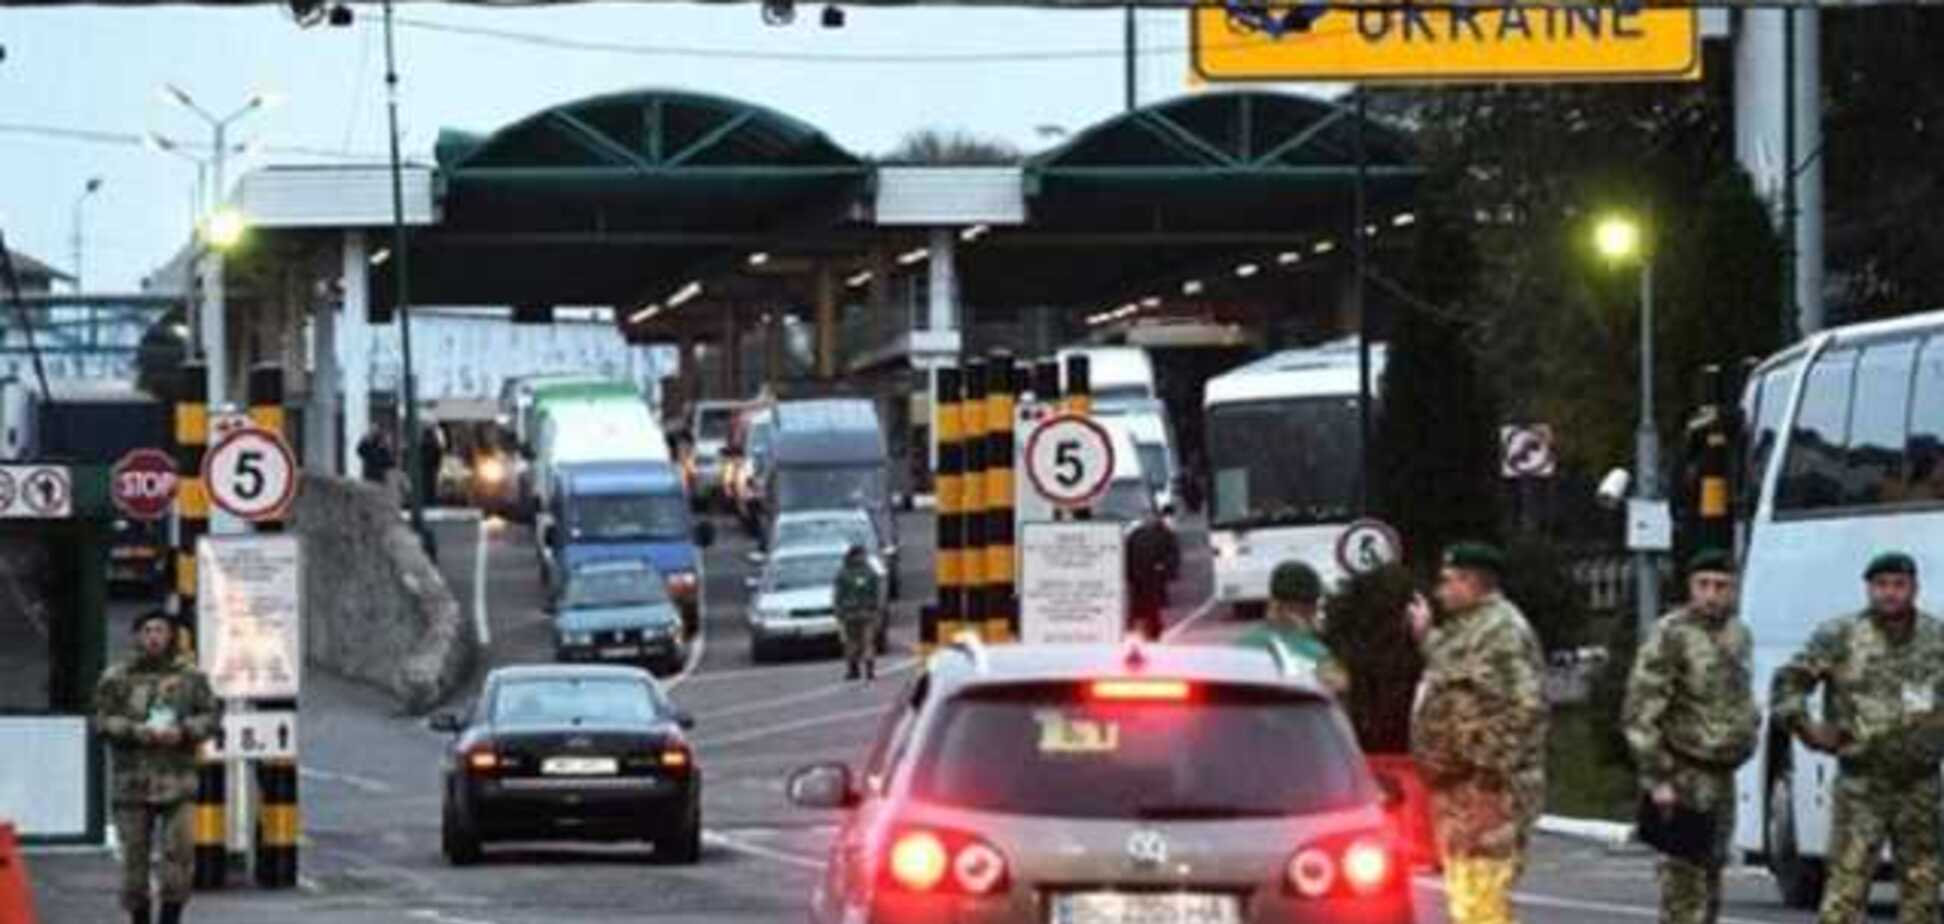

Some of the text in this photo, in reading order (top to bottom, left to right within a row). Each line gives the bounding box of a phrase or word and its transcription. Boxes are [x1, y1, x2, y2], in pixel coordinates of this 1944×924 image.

[1356, 8, 1645, 42] UKRAINE
[119, 470, 176, 498] STOP
[233, 452, 265, 499] 5
[1054, 441, 1084, 487] 5
